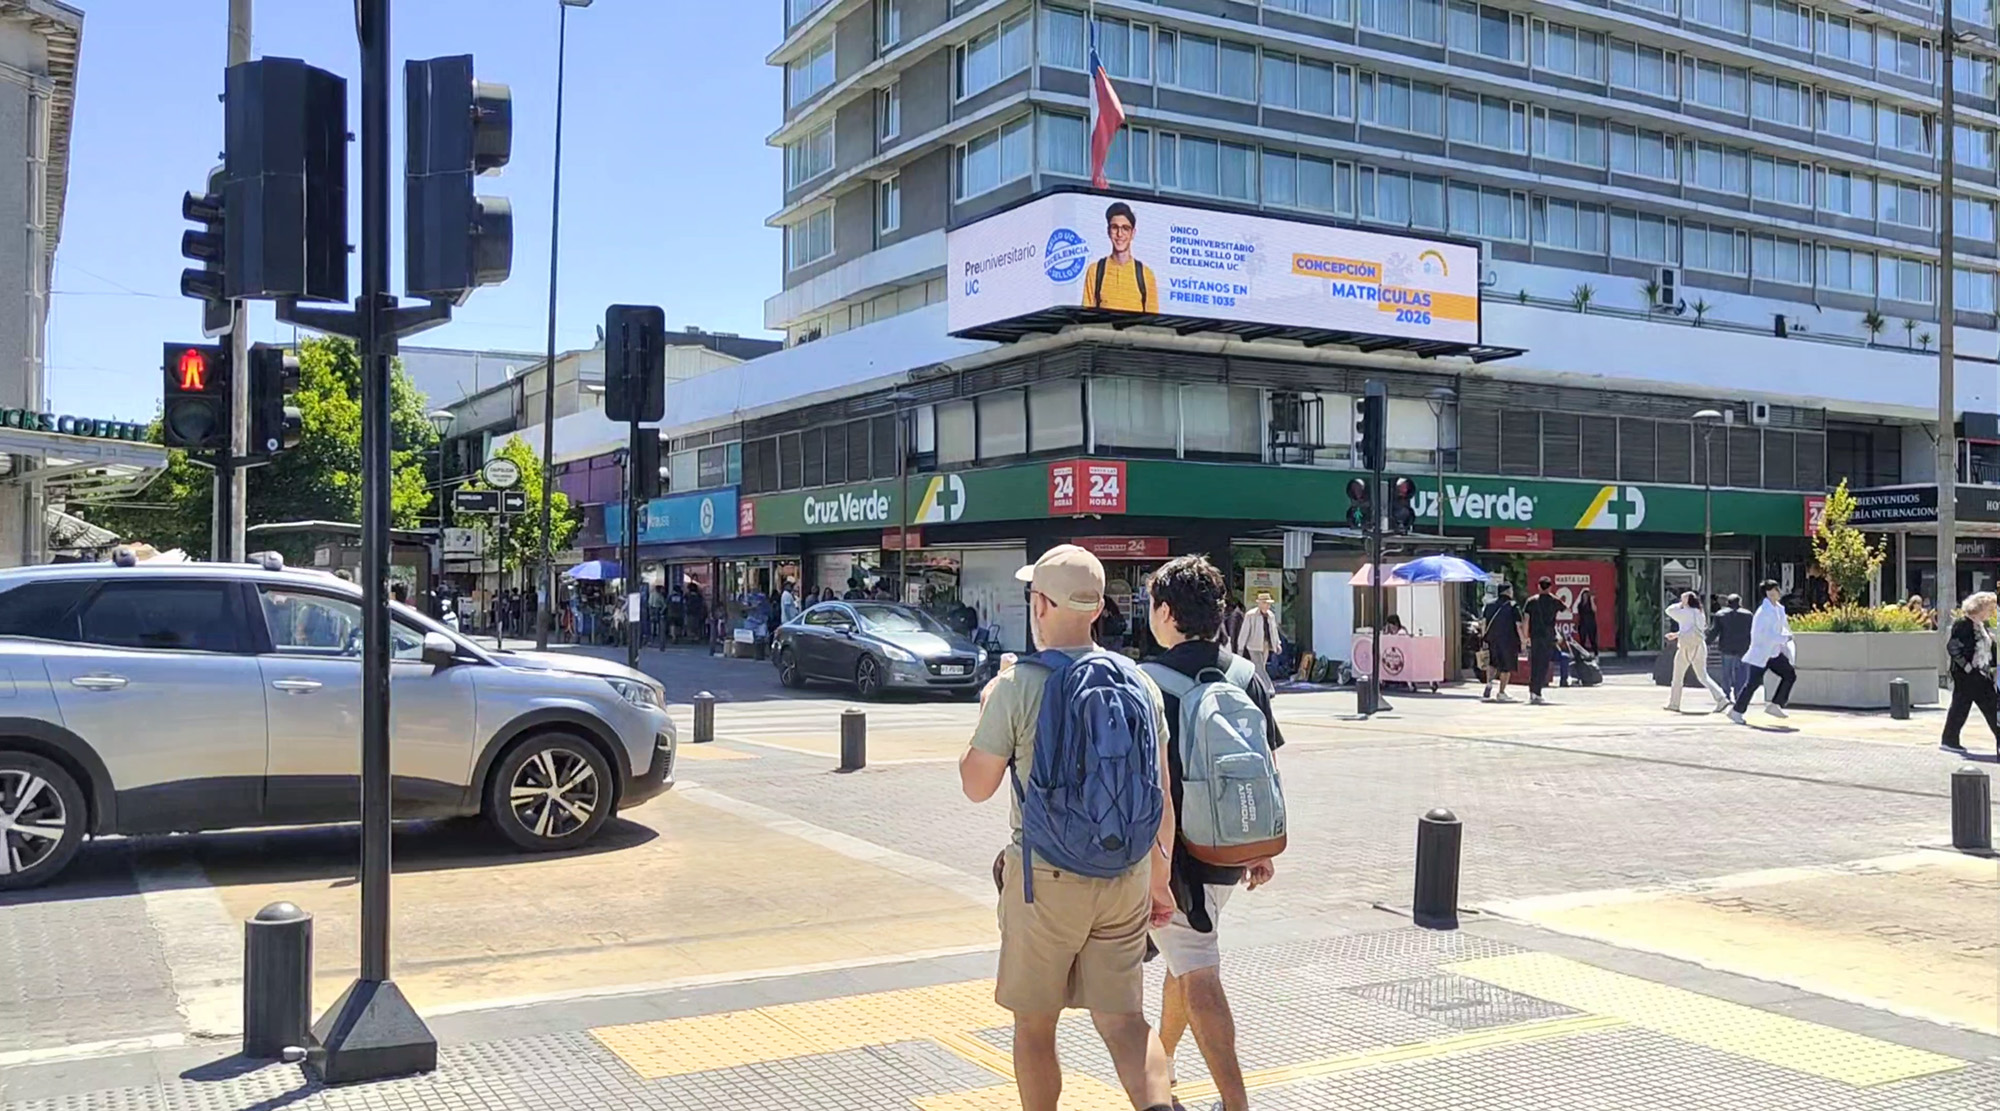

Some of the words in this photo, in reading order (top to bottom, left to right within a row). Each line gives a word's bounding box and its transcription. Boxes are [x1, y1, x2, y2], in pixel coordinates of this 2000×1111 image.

[1170, 223, 1199, 236] ÚNICO
[1170, 235, 1255, 253] PREUNIVERSITARIO
[964, 243, 1036, 277] Preuniversitario
[1169, 246, 1189, 256] CON
[1191, 248, 1202, 257] EL
[1204, 250, 1231, 261] SELLO
[1233, 253, 1246, 262] DE
[1170, 256, 1225, 270] EXCELENCIA
[1226, 262, 1239, 271] UC
[1296, 258, 1376, 277] CONCEPCIÓN
[965, 279, 980, 296] UC
[1169, 277, 1230, 294] VISÍTANOS
[1233, 284, 1248, 295] EN
[1332, 282, 1431, 307] MATRÍCULAS
[1169, 291, 1209, 304] FREIRE
[1211, 295, 1236, 307] 1035
[1395, 308, 1431, 325] 2026
[0, 408, 54, 432] CKS
[1054, 475, 1074, 498] 24
[1089, 475, 1119, 497] 24
[804, 497, 839, 524] Cruz
[840, 489, 889, 521] Verde
[1090, 498, 1117, 506] HORAS
[1409, 490, 1439, 517] uz
[1446, 485, 1533, 521] Verde
[1857, 493, 1920, 506] BIENVENIDOS
[1986, 500, 2000, 511] HO
[1871, 506, 1938, 519] INTERNACIONA
[1127, 540, 1145, 551] 24
[1237, 783, 1249, 833] ARMOUR
[1245, 783, 1257, 822] UNDER
